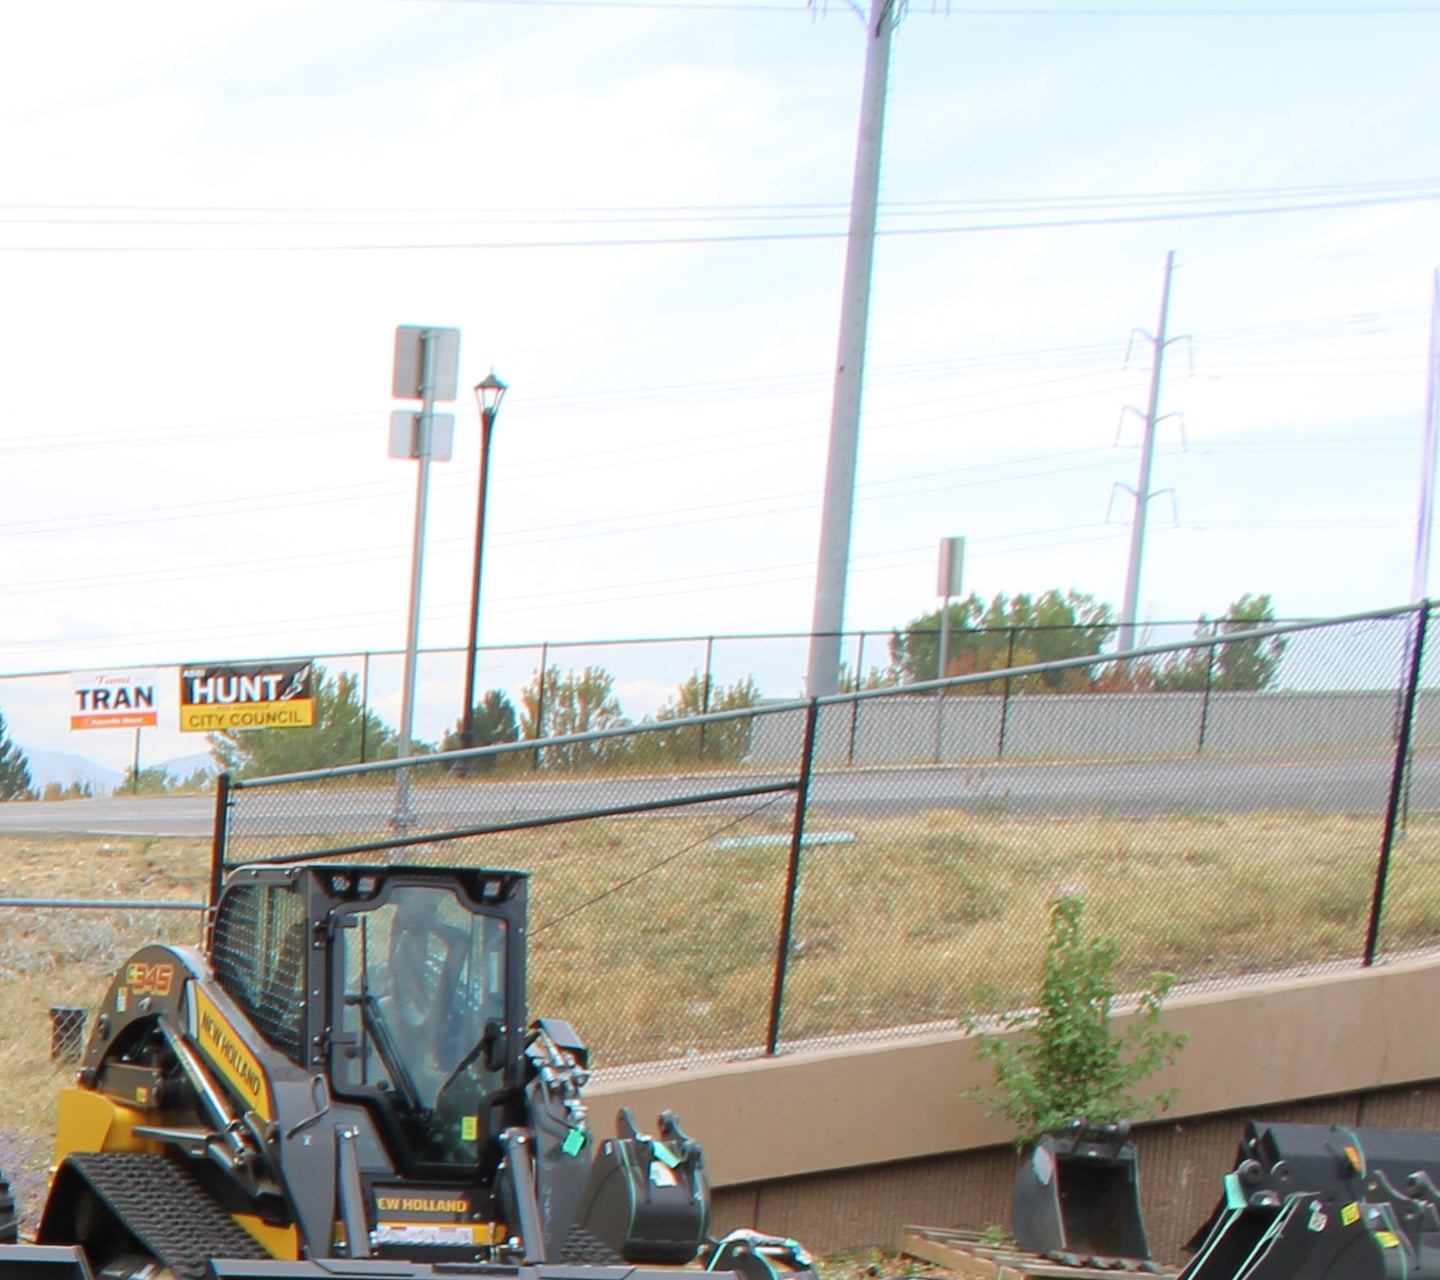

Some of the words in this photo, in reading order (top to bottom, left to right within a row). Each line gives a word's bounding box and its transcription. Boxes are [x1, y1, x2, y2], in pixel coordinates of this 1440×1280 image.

[75, 685, 154, 711] TRAN
[191, 674, 283, 704] HUNT
[189, 713, 225, 728] CITY
[229, 710, 303, 727] COUNCIL
[201, 1011, 224, 1047] NEW
[221, 1037, 260, 1096] HOLLAND
[376, 1198, 401, 1211] EW
[402, 1198, 469, 1213] HOLLAND
